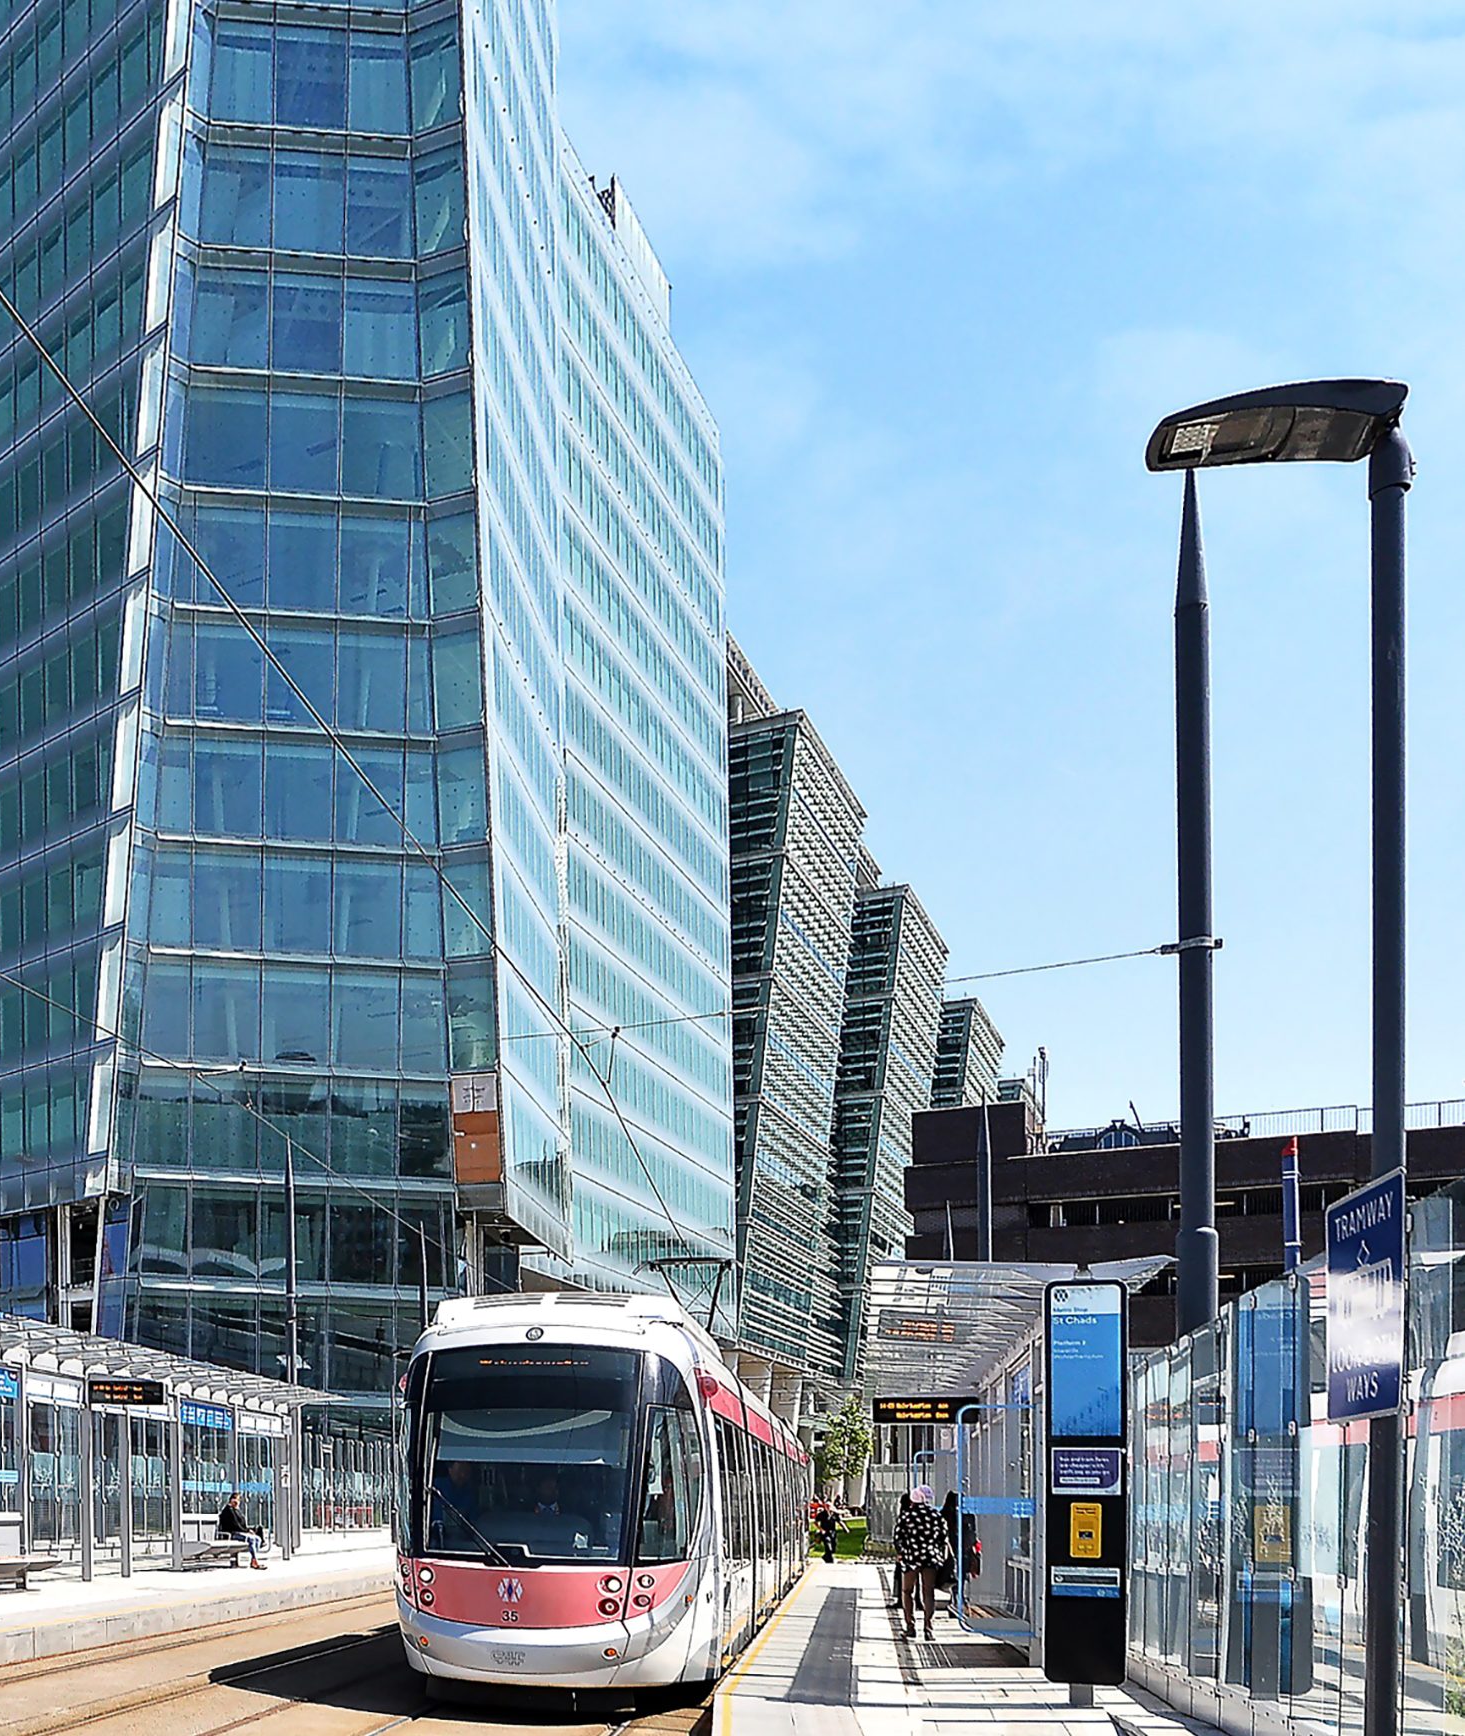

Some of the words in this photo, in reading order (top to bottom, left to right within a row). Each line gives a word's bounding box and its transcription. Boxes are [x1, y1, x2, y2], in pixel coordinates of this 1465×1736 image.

[1334, 1191, 1394, 1244] TRAMWAY
[1053, 1316, 1064, 1325] St
[1065, 1315, 1098, 1325] Chads
[1346, 1371, 1379, 1403] WAYS
[502, 1610, 519, 1622] 35
